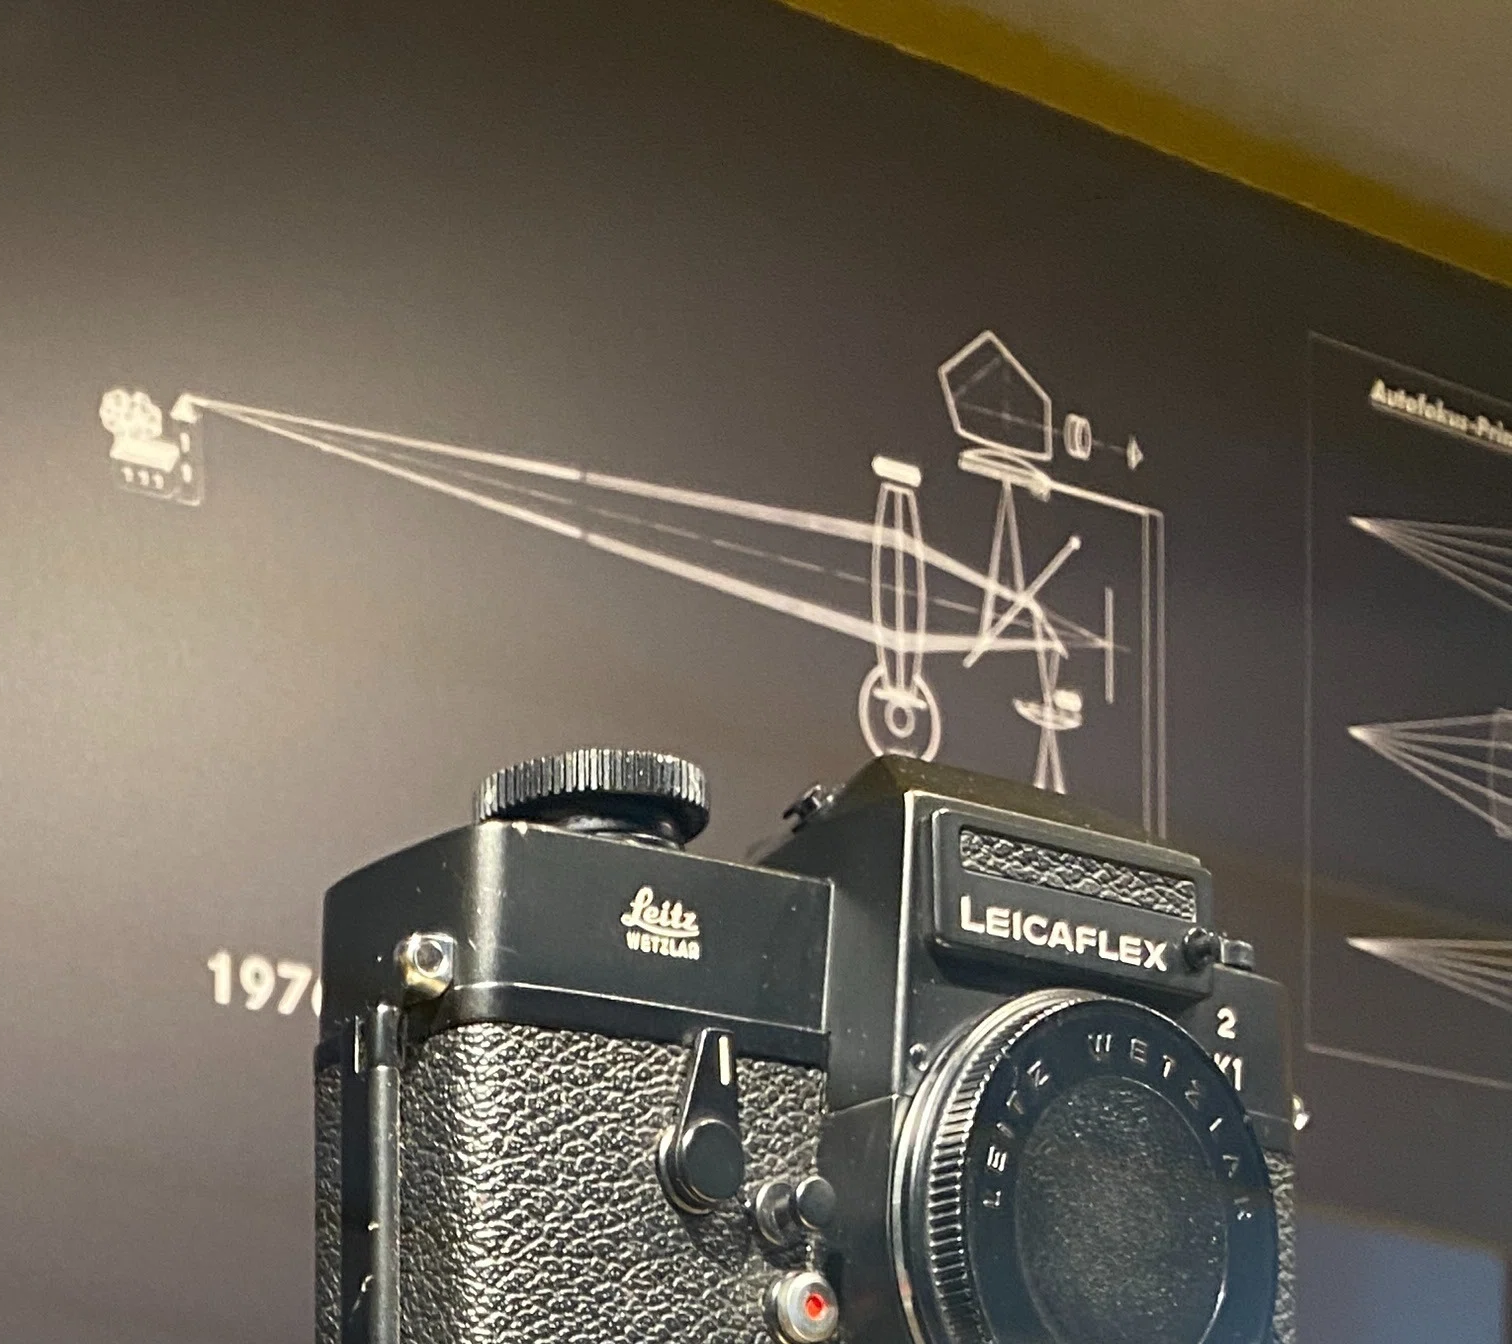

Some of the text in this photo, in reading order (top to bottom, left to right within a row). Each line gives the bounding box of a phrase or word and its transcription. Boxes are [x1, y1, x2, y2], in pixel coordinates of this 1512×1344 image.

[620, 886, 700, 938] Leitz
[626, 930, 700, 960] WETZLAR
[960, 895, 1167, 972] LEICAFLEX
[1216, 1007, 1236, 1039] 2
